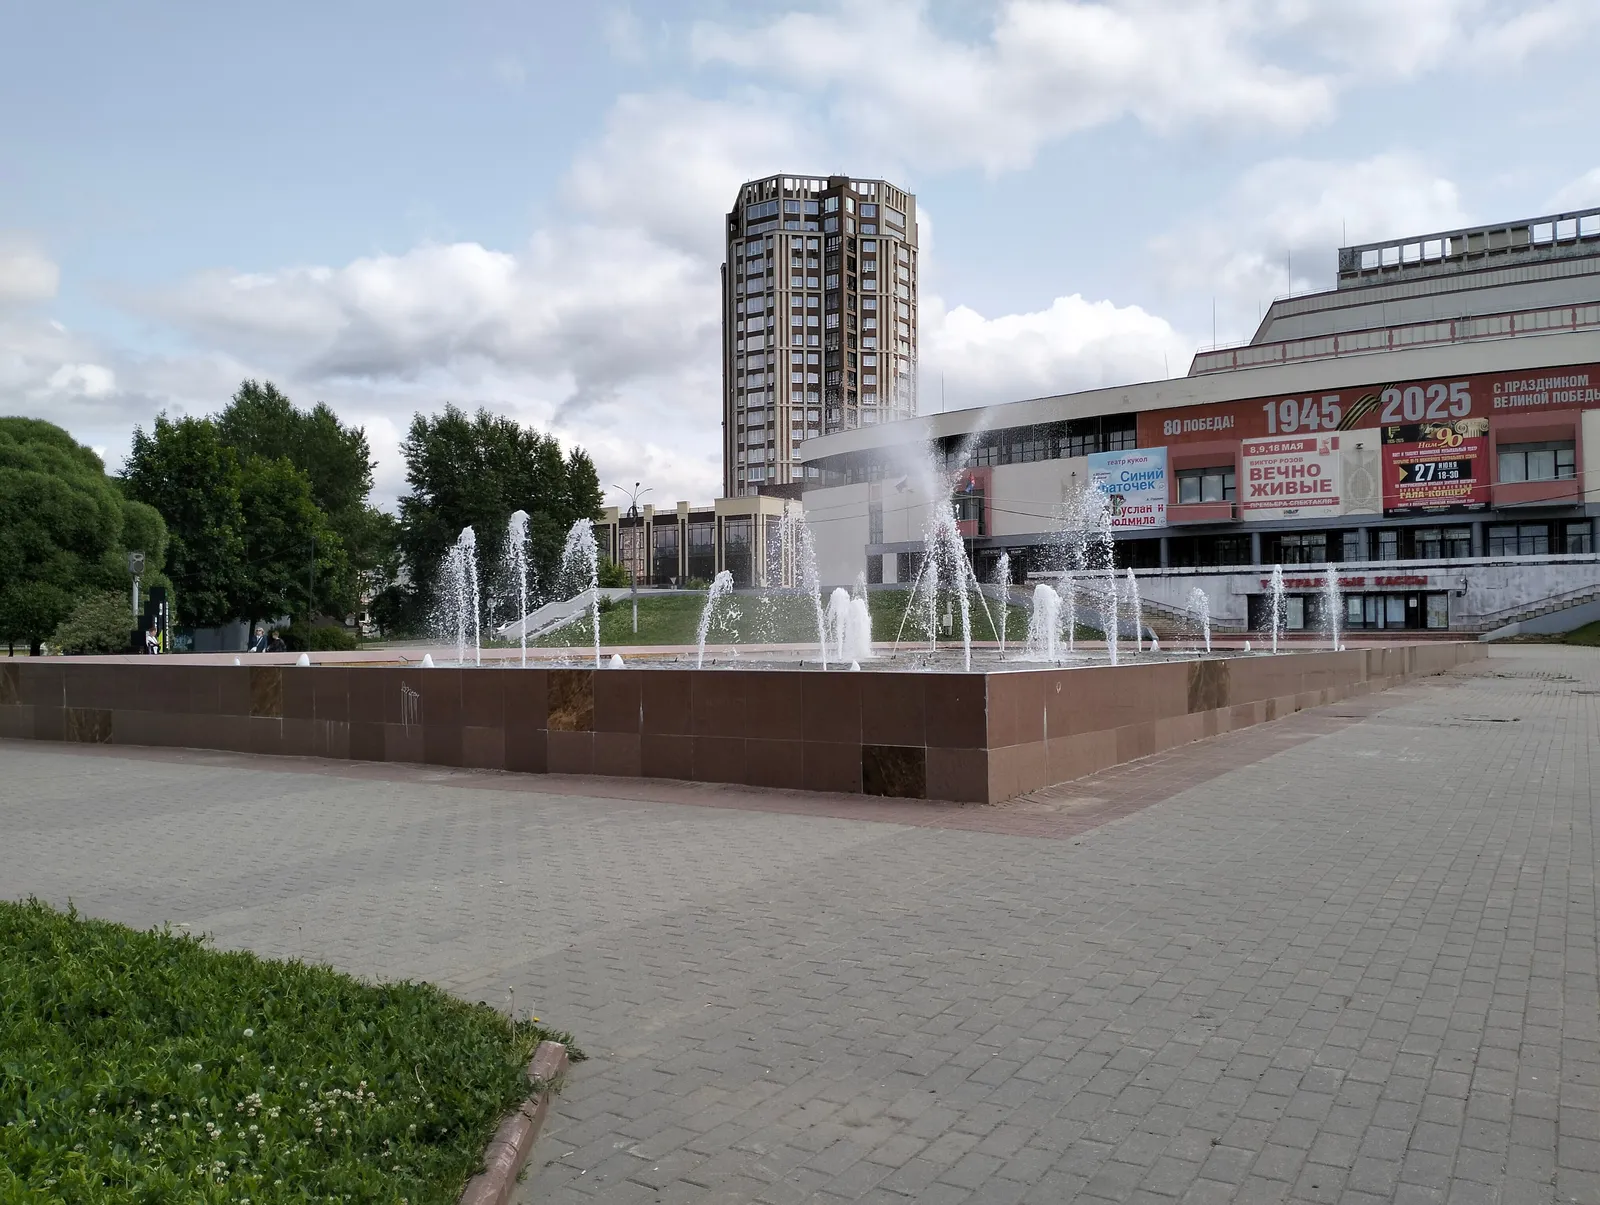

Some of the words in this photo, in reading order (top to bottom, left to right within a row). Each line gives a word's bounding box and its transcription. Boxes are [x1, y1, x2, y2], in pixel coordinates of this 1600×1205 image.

[1493, 382, 1502, 395] С
[1504, 374, 1589, 395] ПРАЗДНИКОМ
[1380, 381, 1472, 424] 2025
[1493, 391, 1550, 409] ВЕЛИКОЙ
[1262, 394, 1342, 434] 1945
[1163, 419, 1181, 437] 80
[1183, 415, 1235, 433] ПОБЕДА!
[1281, 442, 1304, 451] МАЯ
[1417, 441, 1438, 449] Нам
[1436, 427, 1464, 448] 90
[1127, 456, 1148, 465] кукол
[1249, 458, 1278, 467] ВИКТОР
[1279, 456, 1304, 464] РОЗОВ
[1120, 467, 1164, 482] Синий
[1249, 463, 1322, 482] ВЕЧНО
[1414, 462, 1436, 482] 27
[1438, 461, 1457, 469] ИЮНЯ
[1438, 470, 1459, 480] 18-30
[1250, 479, 1333, 498] ЖИВЫЕ
[1249, 500, 1288, 509] ПРЕМЬЕРА
[1289, 498, 1333, 507] СПЕКТАКЛЯ
[1111, 515, 1156, 527] юдмила
[1375, 575, 1428, 586] КАССЫ
